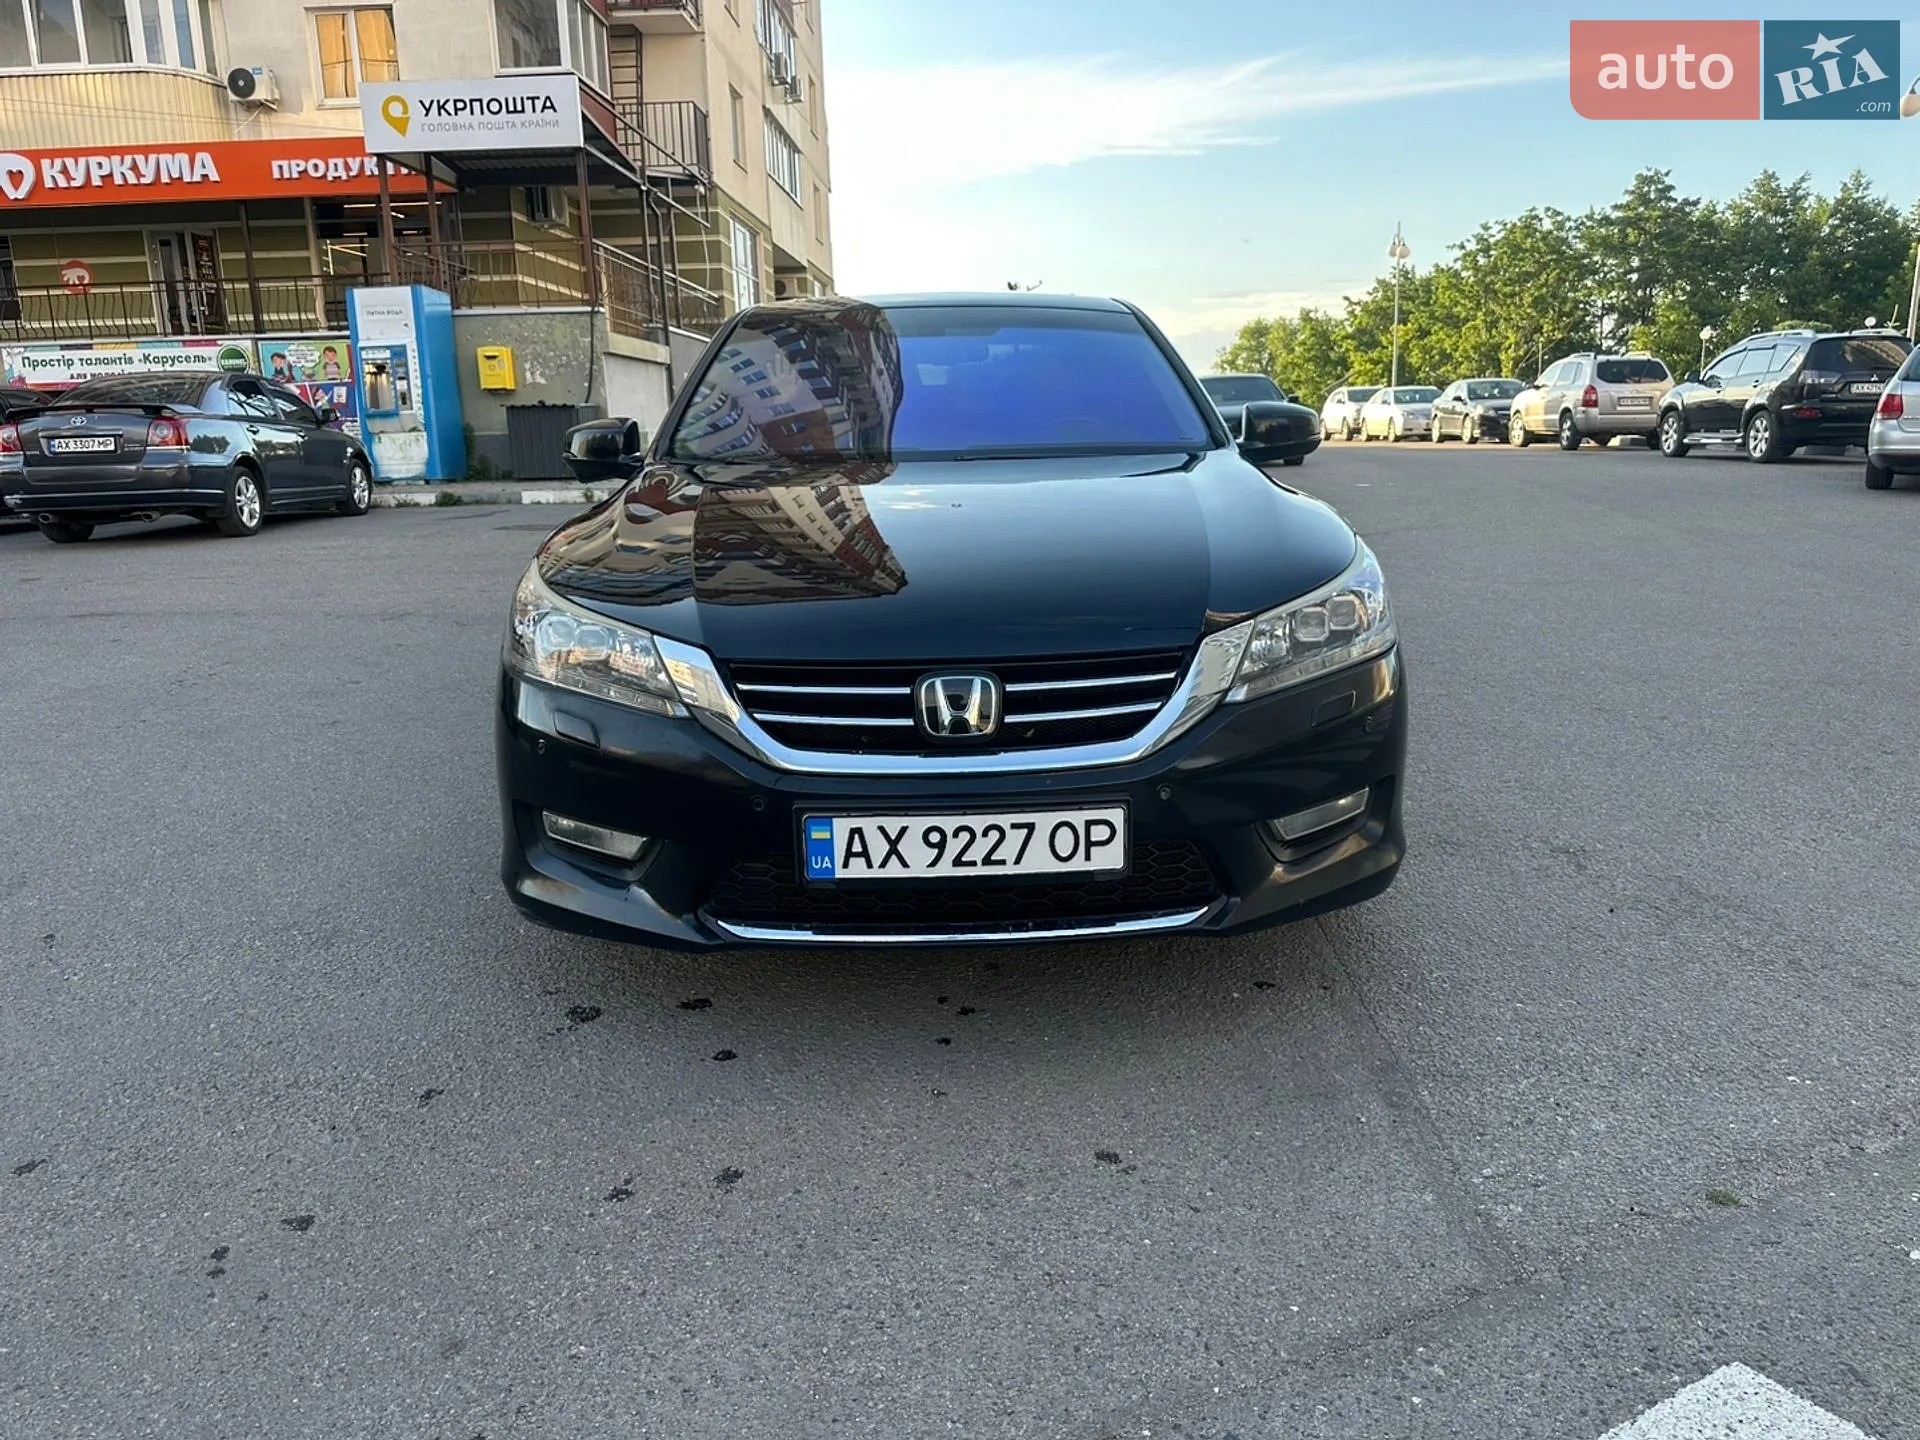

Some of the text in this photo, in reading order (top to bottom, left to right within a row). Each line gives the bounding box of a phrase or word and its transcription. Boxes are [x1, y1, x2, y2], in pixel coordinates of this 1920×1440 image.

[419, 95, 558, 117] УКРПОШТА
[421, 118, 560, 133] ГОЛОВНА ПОШТА КРАЇНИ
[40, 151, 221, 189] КУРКУМА
[21, 353, 75, 371] Простір
[78, 352, 135, 367] талантів
[57, 439, 71, 450] AX
[72, 438, 96, 449] 3307
[842, 818, 1117, 869] AX 9227 OP
[811, 856, 832, 869] UA
